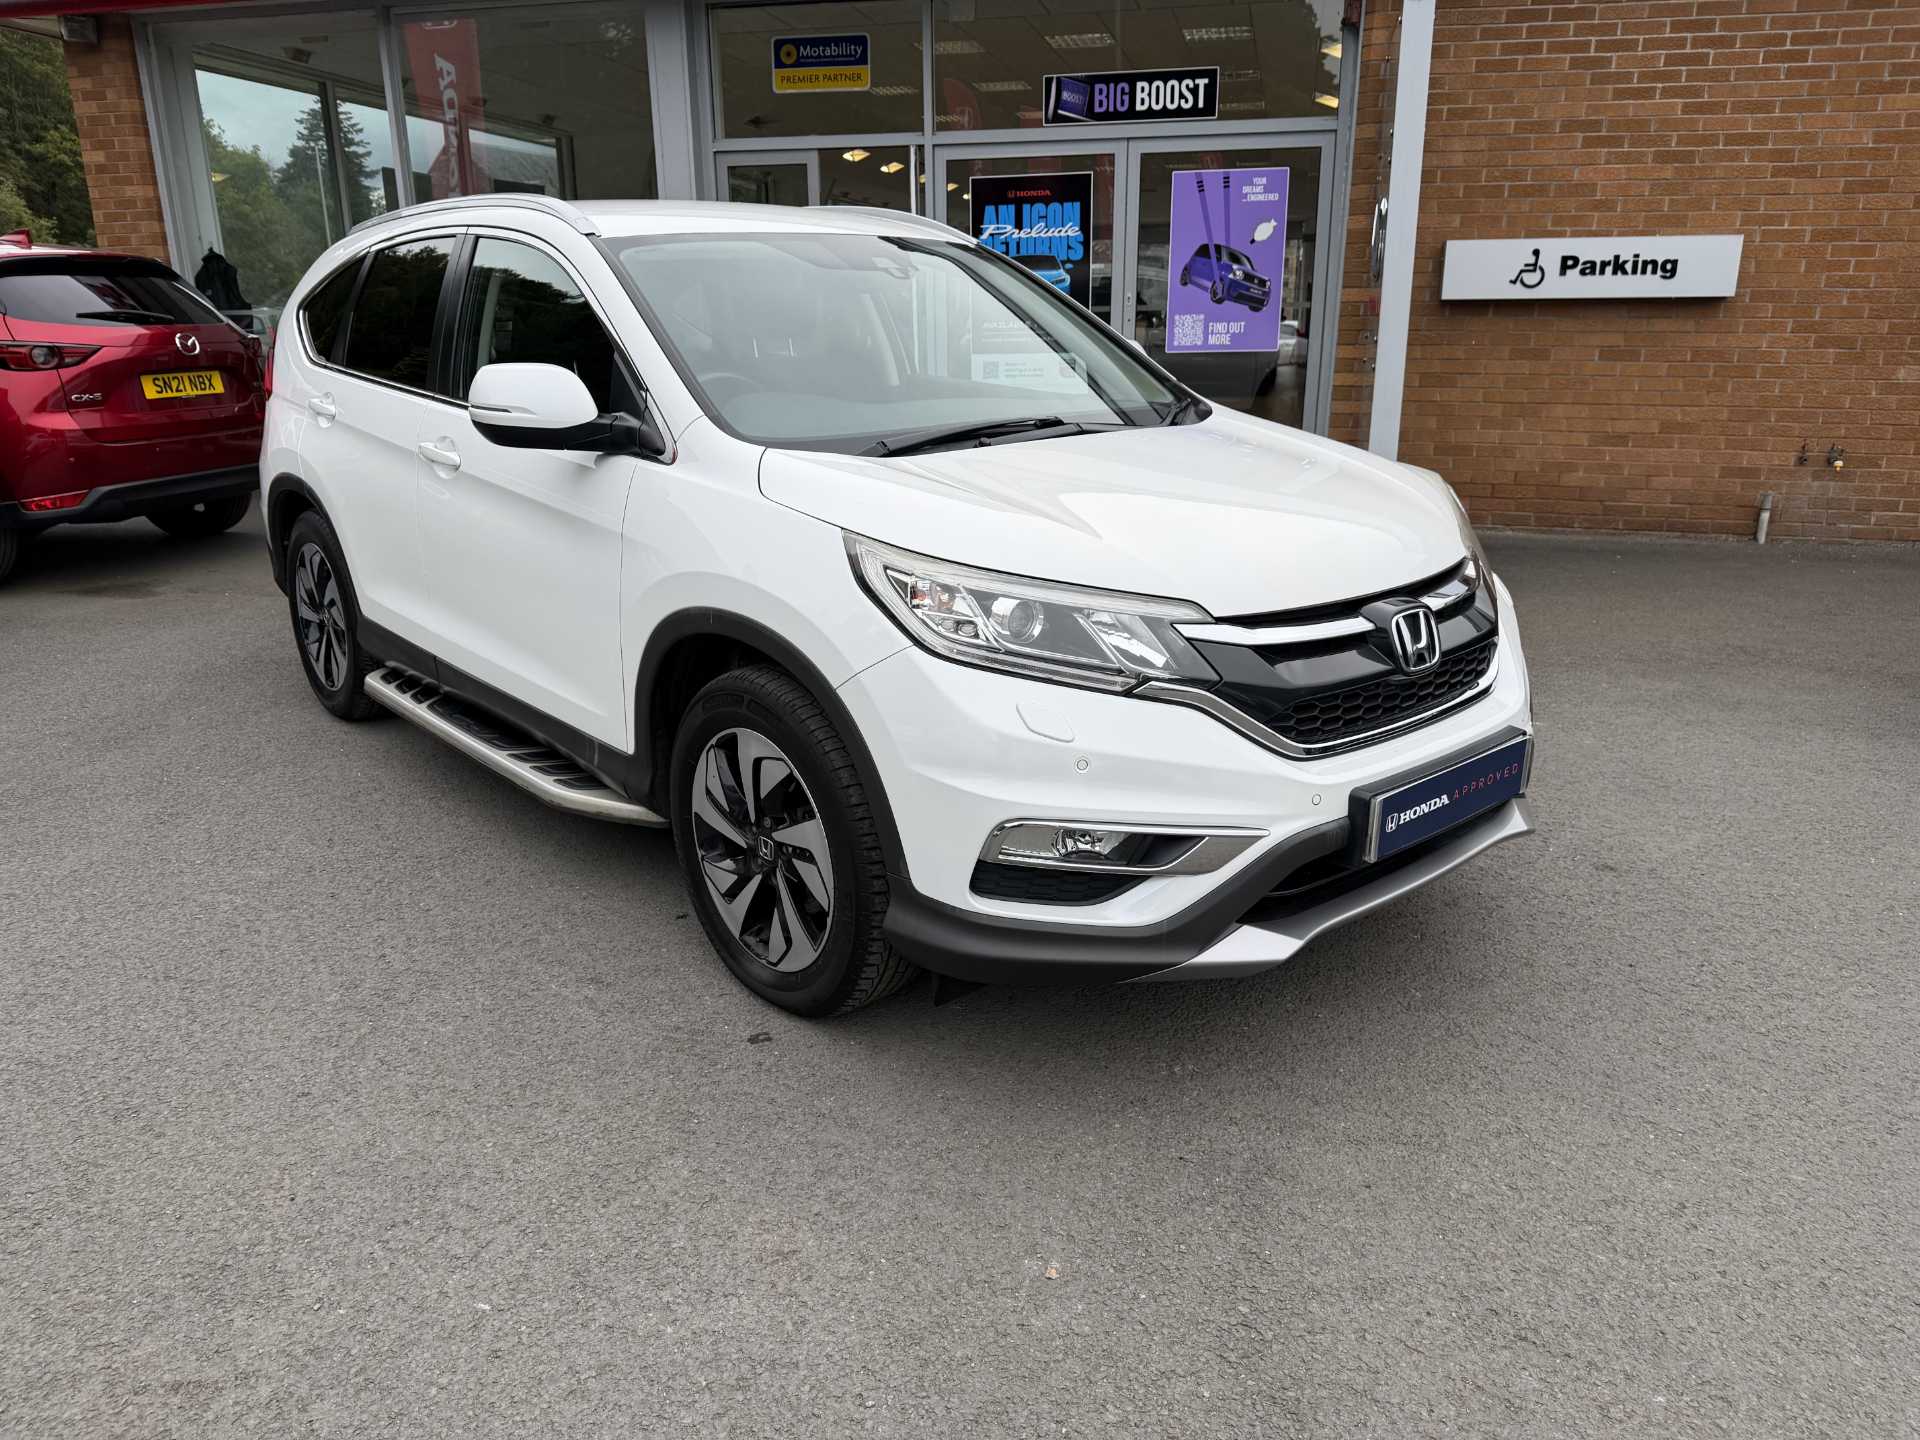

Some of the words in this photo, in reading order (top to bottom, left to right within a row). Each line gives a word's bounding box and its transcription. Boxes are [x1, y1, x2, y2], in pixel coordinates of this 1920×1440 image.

[799, 42, 863, 59] Motability
[780, 74, 821, 85] PREMIER
[822, 72, 864, 83] PARTNER
[1094, 82, 1130, 113] BIG
[1135, 78, 1209, 112] BOOST
[1252, 176, 1267, 185] YOUR
[1016, 189, 1052, 197] HONDA
[1242, 185, 1265, 194] DREAMS
[982, 204, 1015, 233] AN
[1022, 201, 1081, 233] ICON
[980, 222, 1082, 240] Prelude
[1558, 253, 1679, 280] Parking
[1208, 322, 1228, 334] FIND
[1229, 321, 1246, 333] OUT
[1207, 334, 1232, 345] MORE
[152, 375, 186, 394] SN21
[189, 373, 216, 391] NBX
[71, 393, 103, 402] CX-5
[1398, 793, 1450, 825] HONDA
[1452, 763, 1521, 801] APPROVED
